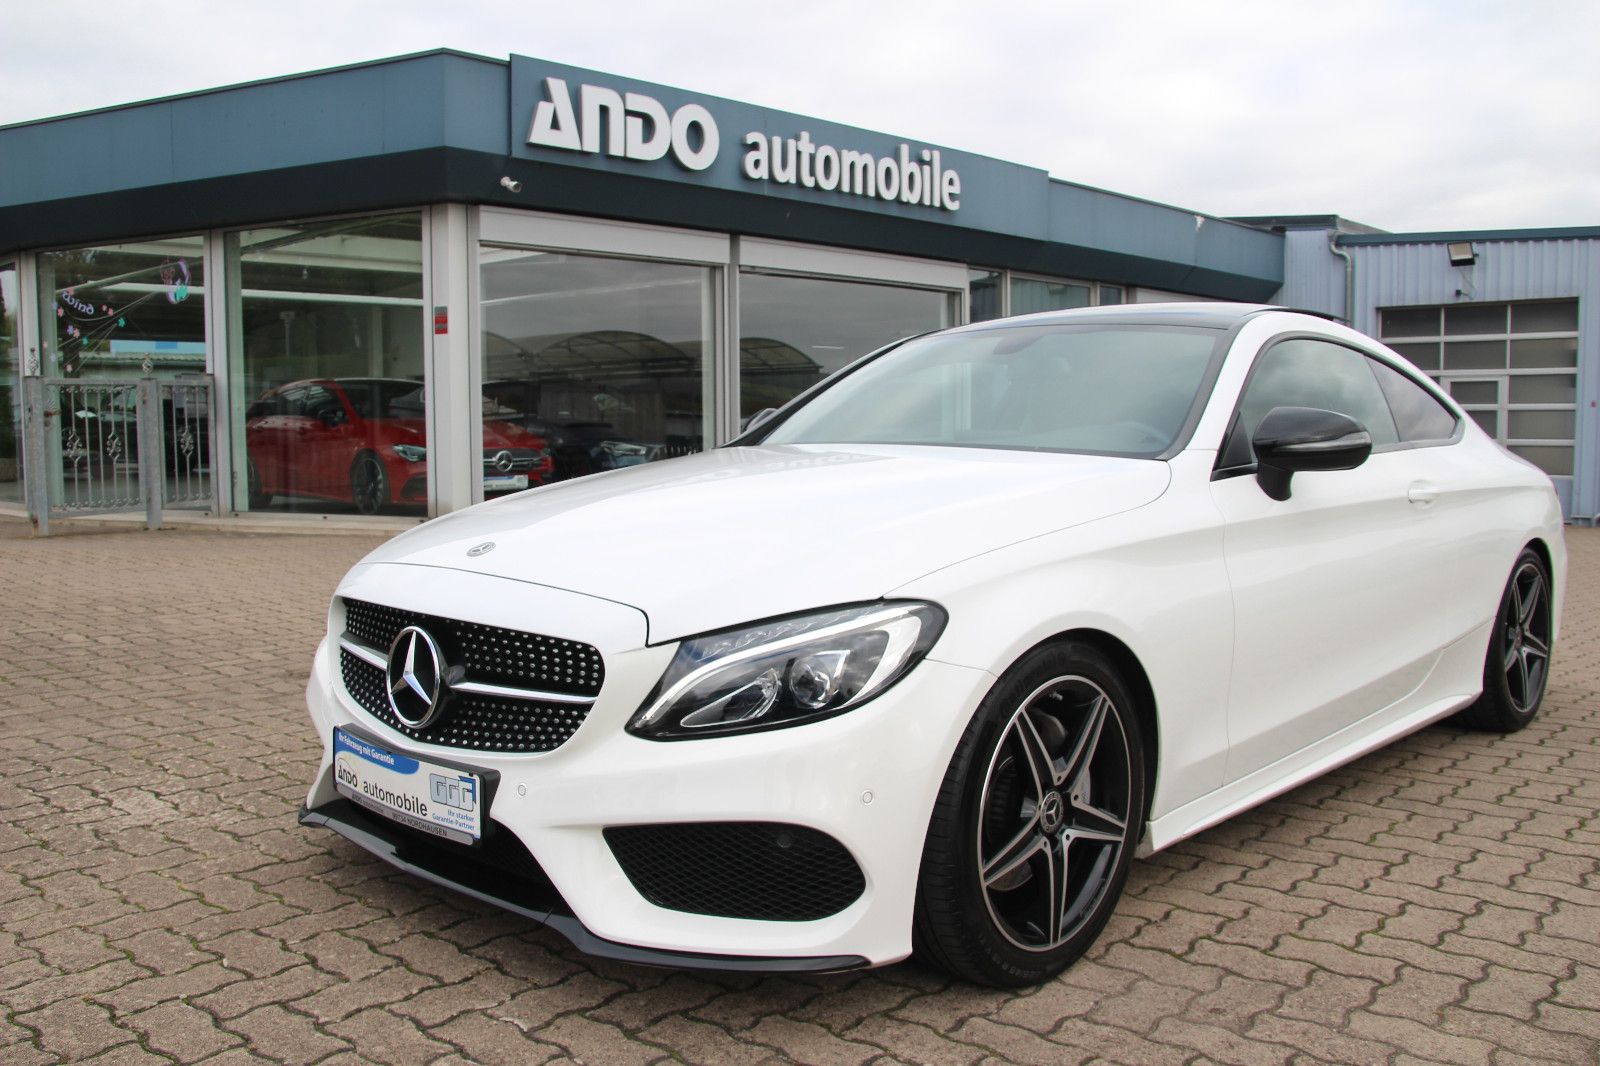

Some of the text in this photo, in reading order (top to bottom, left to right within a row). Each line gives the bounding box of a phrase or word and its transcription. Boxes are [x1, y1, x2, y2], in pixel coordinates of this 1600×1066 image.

[526, 77, 961, 211] ANDO automobile
[363, 745, 371, 757] mit
[371, 749, 395, 766] Garantie
[363, 781, 428, 817] automobile
[455, 811, 475, 822] starker
[407, 818, 448, 837] NORDHAUSEN
